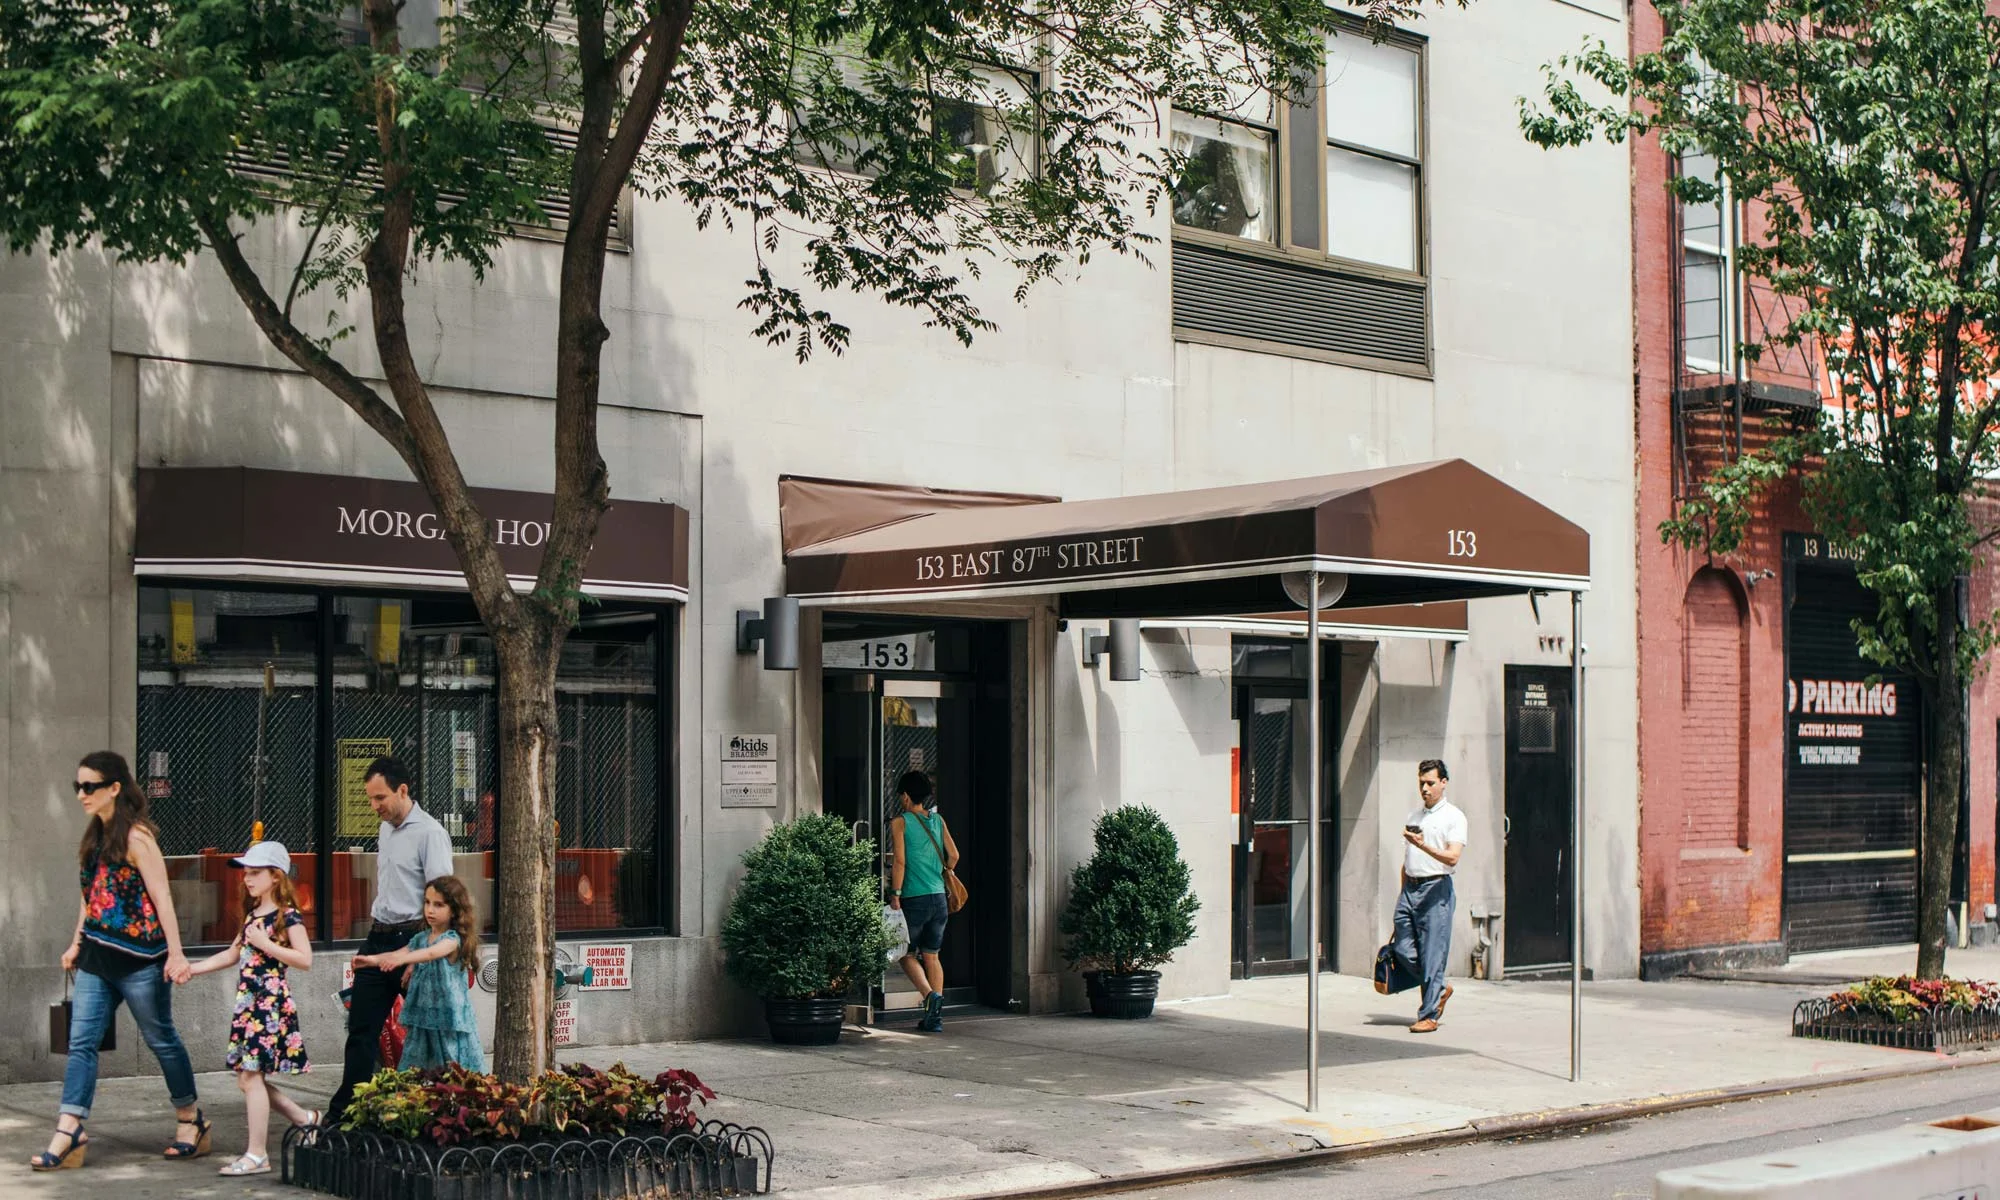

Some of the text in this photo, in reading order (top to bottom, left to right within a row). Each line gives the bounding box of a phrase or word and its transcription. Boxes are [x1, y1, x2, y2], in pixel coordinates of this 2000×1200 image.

[337, 506, 447, 540] MORG
[1447, 529, 1477, 557] 153
[1804, 538, 1819, 557] 13
[916, 555, 944, 580] 153
[951, 550, 1004, 578] EAST
[1057, 536, 1144, 569] STREET
[860, 642, 908, 668] 153
[1802, 679, 1897, 716] PARKING
[1798, 722, 1863, 738] ACTIVE 24 HOURS
[740, 738, 768, 752] kids
[586, 947, 626, 957] AUTOMATIC
[586, 957, 625, 967] SPRINKLER
[592, 967, 624, 977] YSTEM IN
[590, 977, 628, 987] LLAR ONLY
[556, 1010, 570, 1018] OFF
[560, 1018, 576, 1026] FEET
[554, 1027, 569, 1035] SITE
[554, 1035, 570, 1043] IGN
